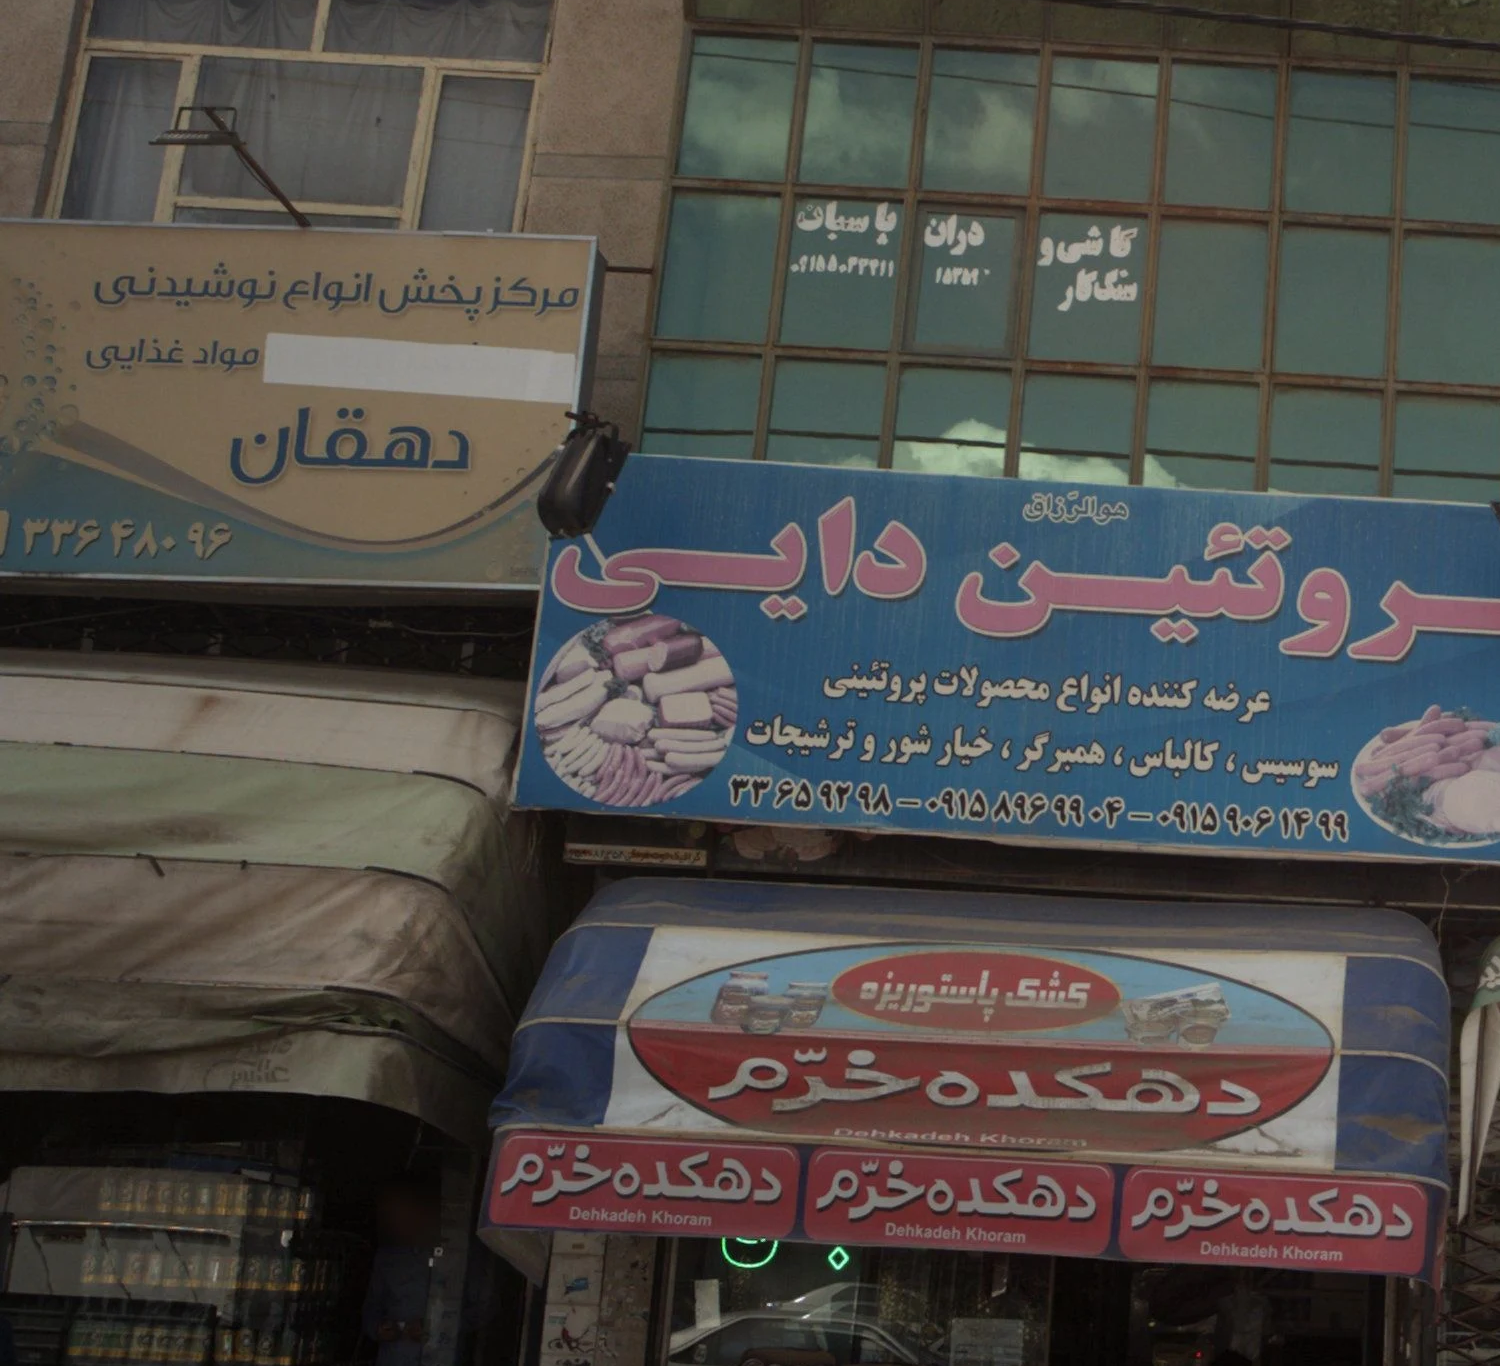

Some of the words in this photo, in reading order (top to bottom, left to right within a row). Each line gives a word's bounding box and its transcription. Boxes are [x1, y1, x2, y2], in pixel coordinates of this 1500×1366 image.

[94, 262, 276, 307] نوشیدنی
[284, 272, 371, 315] انواع
[378, 268, 482, 321] پخش
[488, 274, 579, 317] مرکز
[86, 337, 184, 371] غذایی
[193, 342, 259, 372] مواد
[229, 406, 470, 486] دهقان
[552, 496, 927, 620] دایی
[823, 659, 928, 706] پروتئینی
[933, 665, 1050, 708] محصولات
[1056, 672, 1122, 715] انواع
[1127, 679, 1197, 710] کننده
[1203, 683, 1271, 722] عرضه
[746, 714, 857, 760] ترشیجات
[859, 732, 877, 762] و
[860, 970, 999, 1022] پاستوریزه
[1004, 970, 1091, 1010] کشک
[925, 1062, 1262, 1116] دهکده
[612, 1151, 783, 1202] دهکده
[926, 1168, 1097, 1220] دهکده
[569, 1206, 648, 1224] Dehkadeh
[651, 1208, 713, 1227] Khoram
[884, 1221, 961, 1241] Dehkadeh
[965, 1226, 1027, 1245] Khoram
[1243, 1188, 1414, 1241] دهکده
[1200, 1241, 1279, 1259] Dehkadeh
[1282, 1245, 1344, 1263] Khoram
